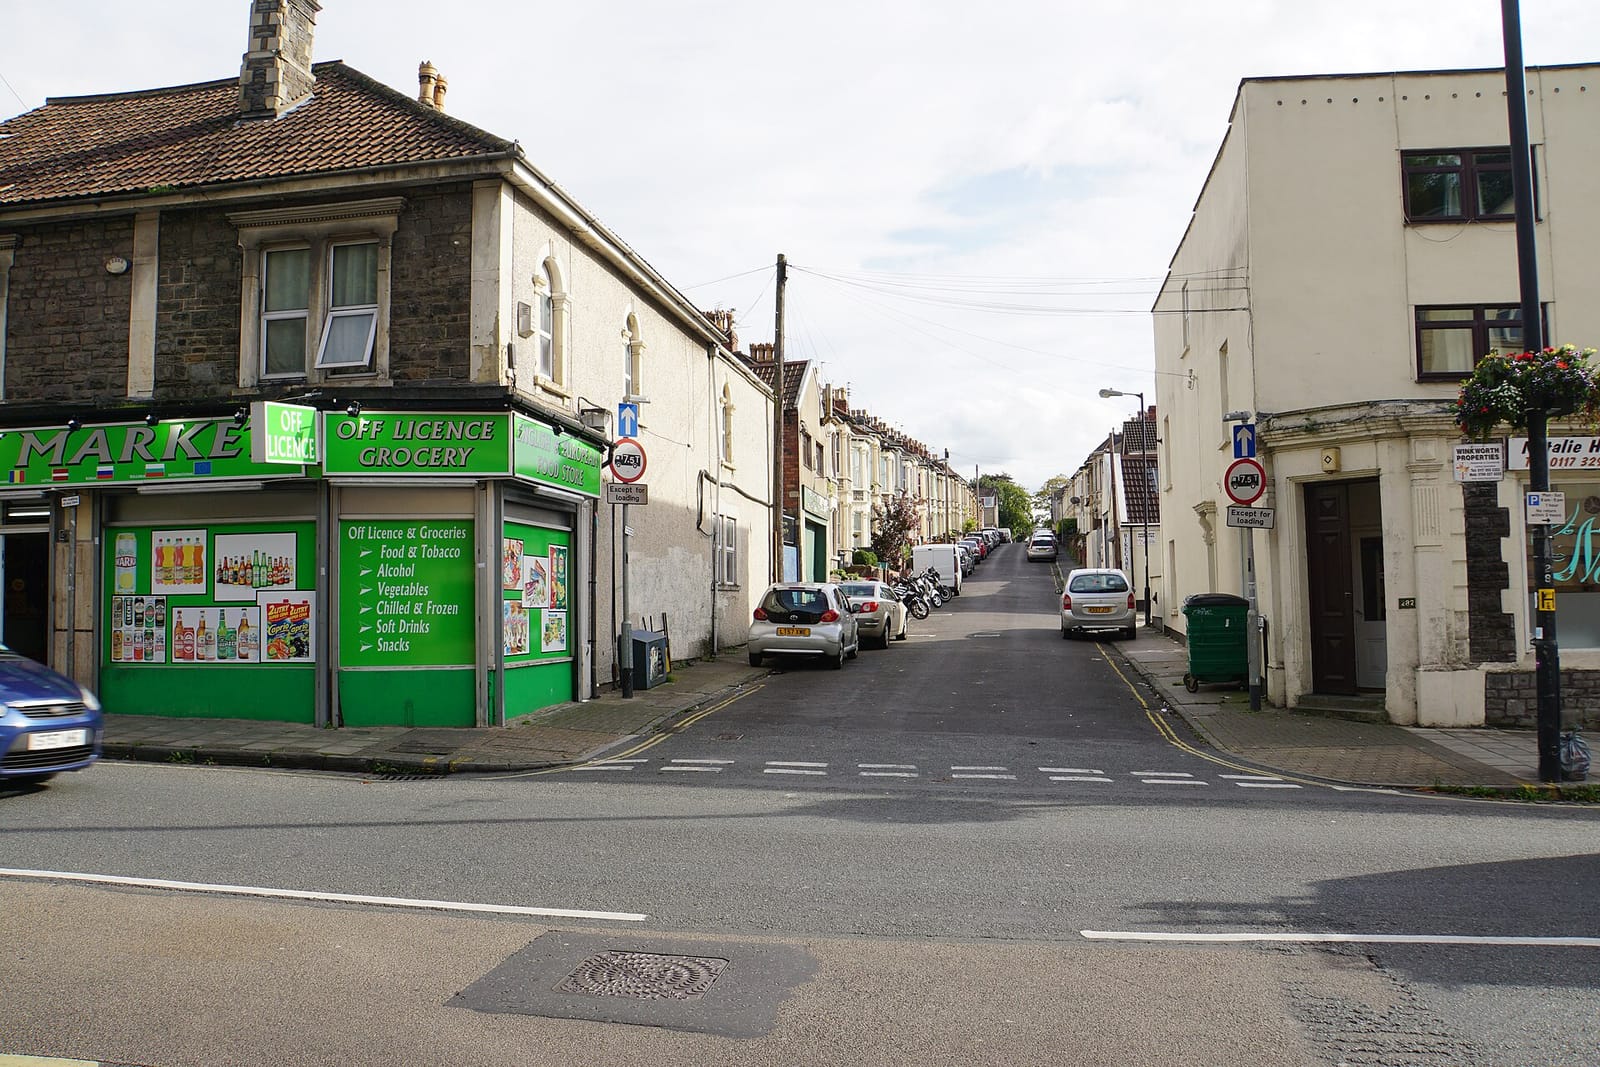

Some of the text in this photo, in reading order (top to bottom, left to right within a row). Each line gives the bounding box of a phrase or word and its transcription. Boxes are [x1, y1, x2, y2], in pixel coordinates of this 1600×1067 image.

[280, 410, 303, 432] OFF
[336, 419, 496, 440] OFF LICENCE
[14, 422, 251, 467] MARKE
[267, 434, 316, 460] LICENCE
[1455, 447, 1500, 455] WINKWORTH
[359, 447, 474, 467] GROCERY
[561, 441, 599, 468] EUROPEAN
[623, 455, 640, 464] 7.5T
[1550, 457, 1576, 467] 0117
[536, 456, 584, 487] FOOD STORE
[610, 485, 632, 493] Except
[615, 494, 640, 502] loading
[1231, 509, 1271, 518] Except for
[1237, 517, 1264, 526] loading
[348, 526, 467, 539] Off Licence & Groceries
[381, 545, 460, 558] Food & Tobacco
[377, 563, 415, 577] Alcohol
[378, 582, 429, 598] Vegetables
[376, 601, 458, 614] Chilled & Frozen
[376, 619, 430, 633] Soft Drinks
[377, 638, 410, 651] Snacks
